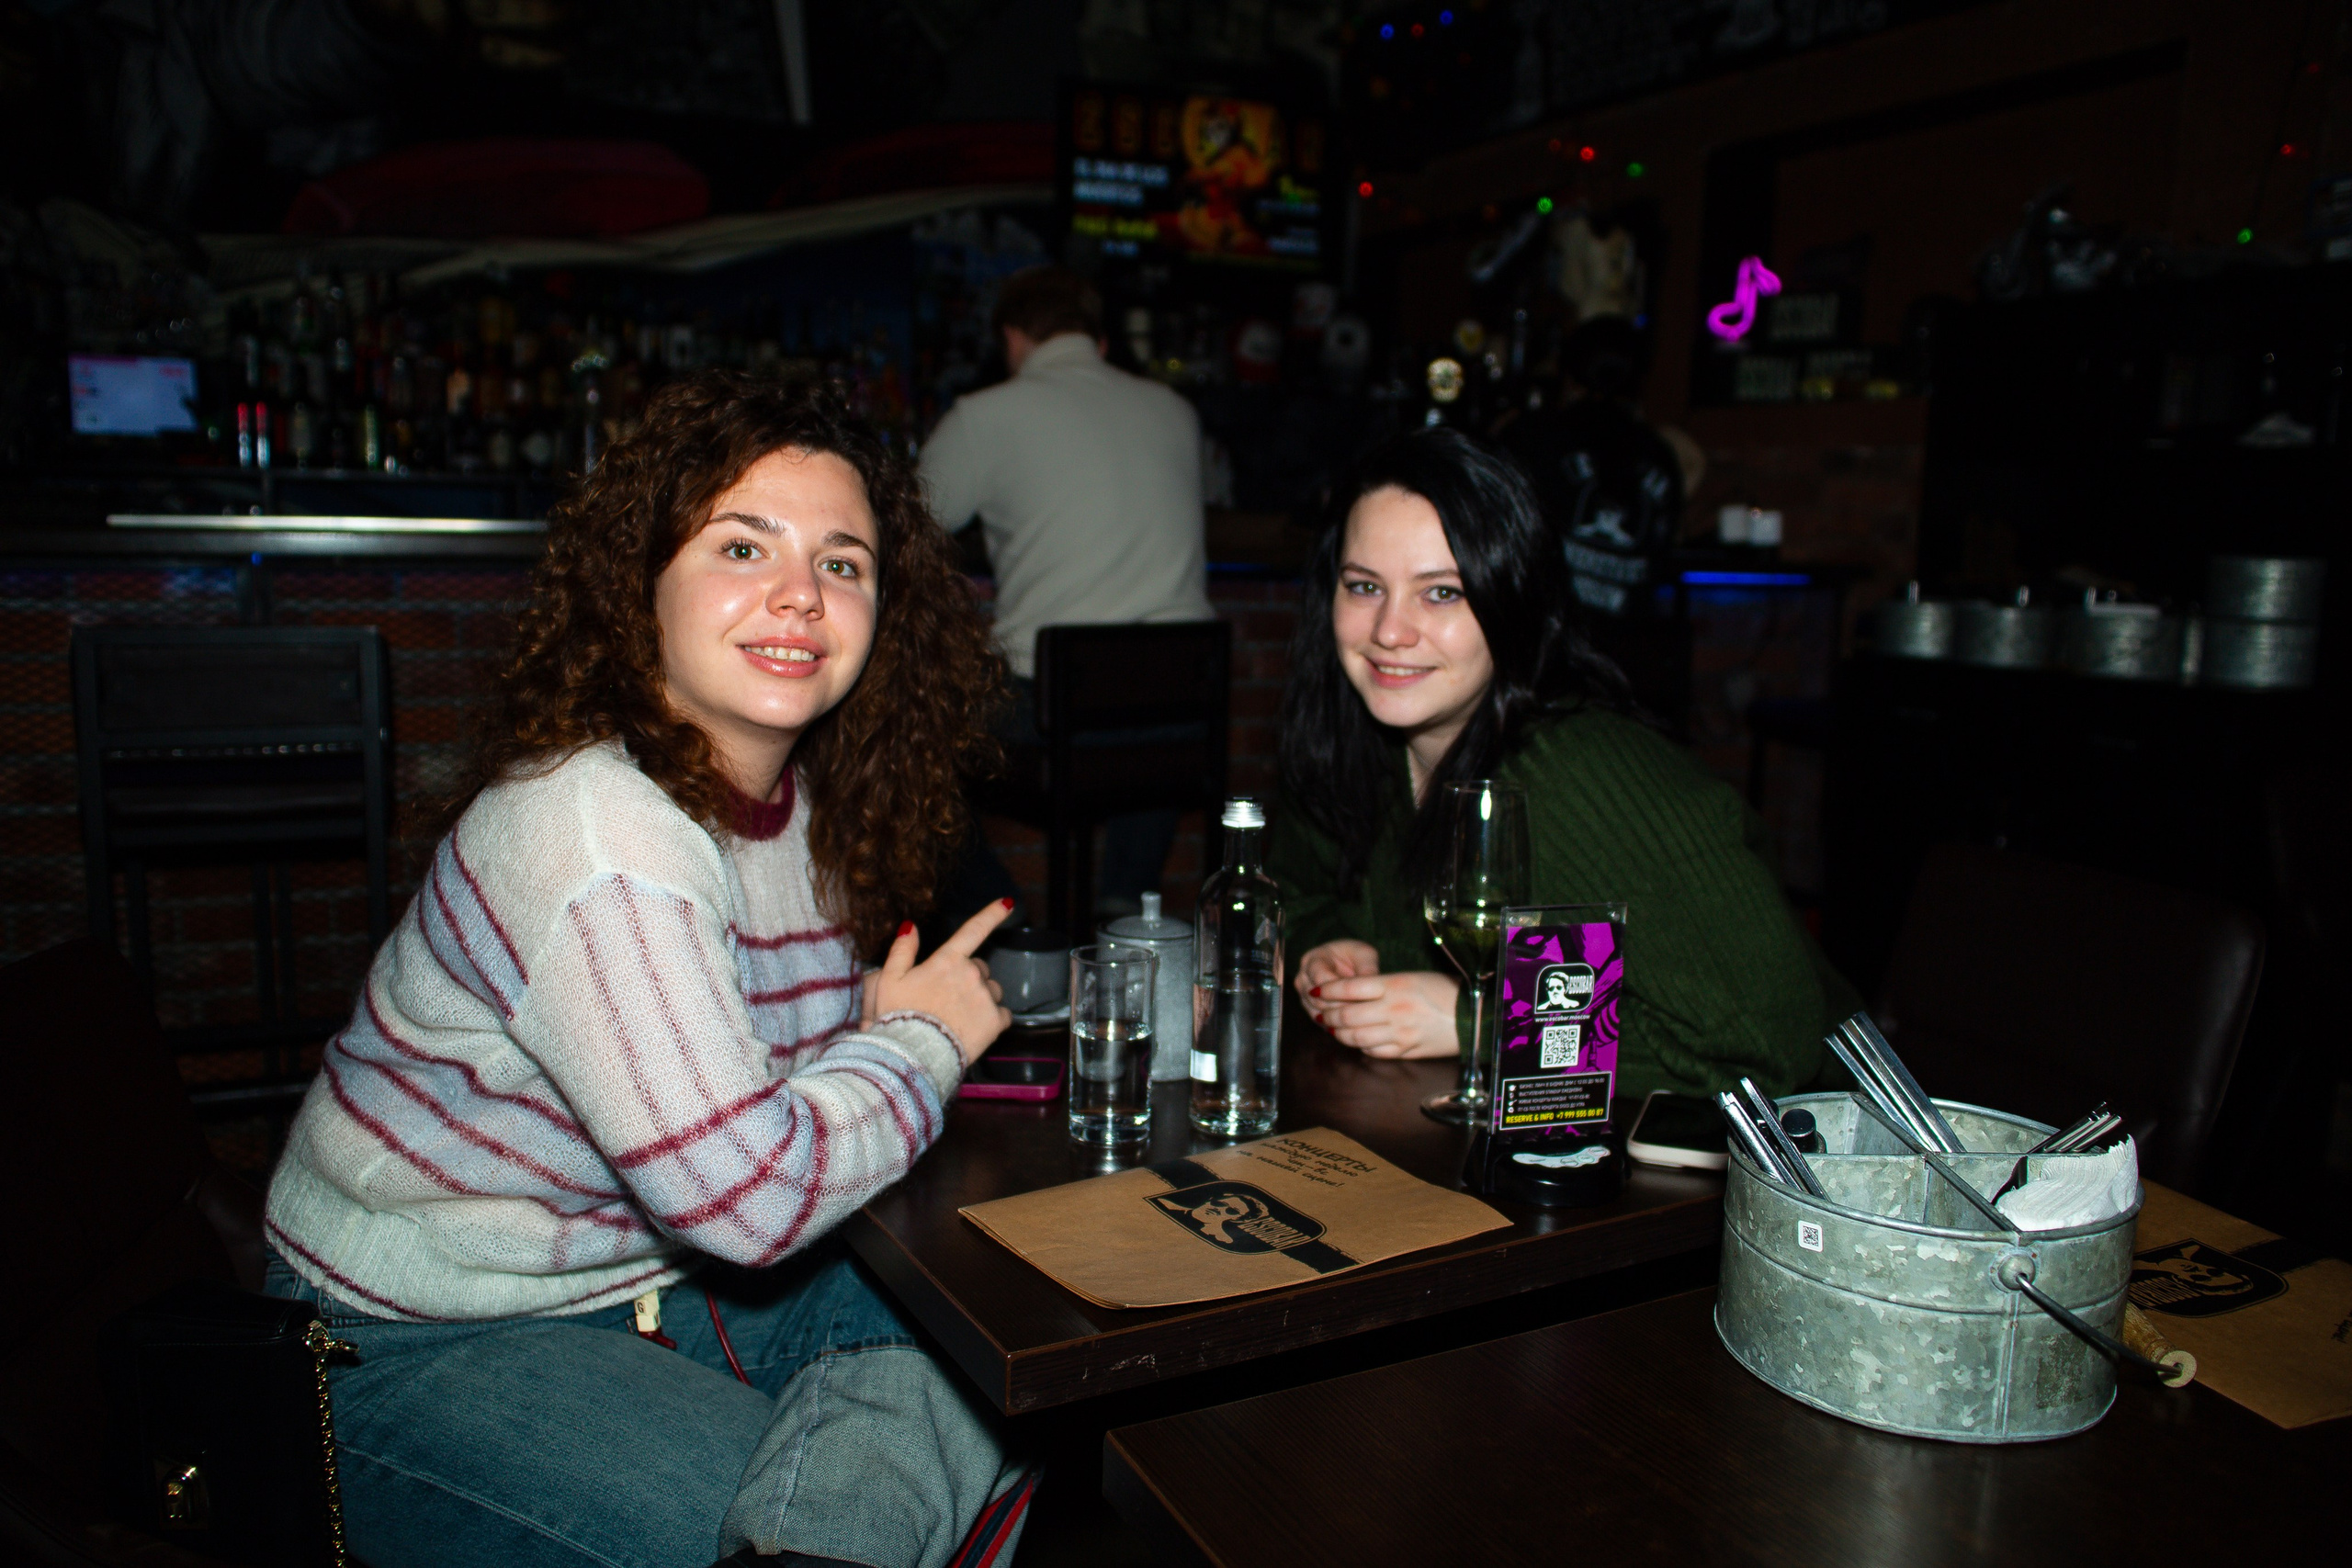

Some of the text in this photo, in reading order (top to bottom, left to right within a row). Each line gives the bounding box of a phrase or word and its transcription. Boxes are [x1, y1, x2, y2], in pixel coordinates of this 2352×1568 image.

[1568, 976, 1593, 994] ESCOBAR
[1534, 1014, 1590, 1022] www.escobar.moscow
[1505, 1114, 1533, 1123] RESERVE
[1540, 1112, 1555, 1121] INFO
[1556, 1111, 1564, 1120] +7
[1576, 1110, 1587, 1118] 555
[1588, 1109, 1595, 1117] 00
[1596, 1108, 1604, 1116] 87
[1261, 1143, 1358, 1178] каждую неделю
[1276, 1138, 1377, 1172] КОНЦЕРТЫ
[1257, 1156, 1302, 1173] нашей
[1302, 1172, 1345, 1188] сцене!
[1237, 1216, 1312, 1249] ESCOBAR
[637, 1302, 645, 1314] G
